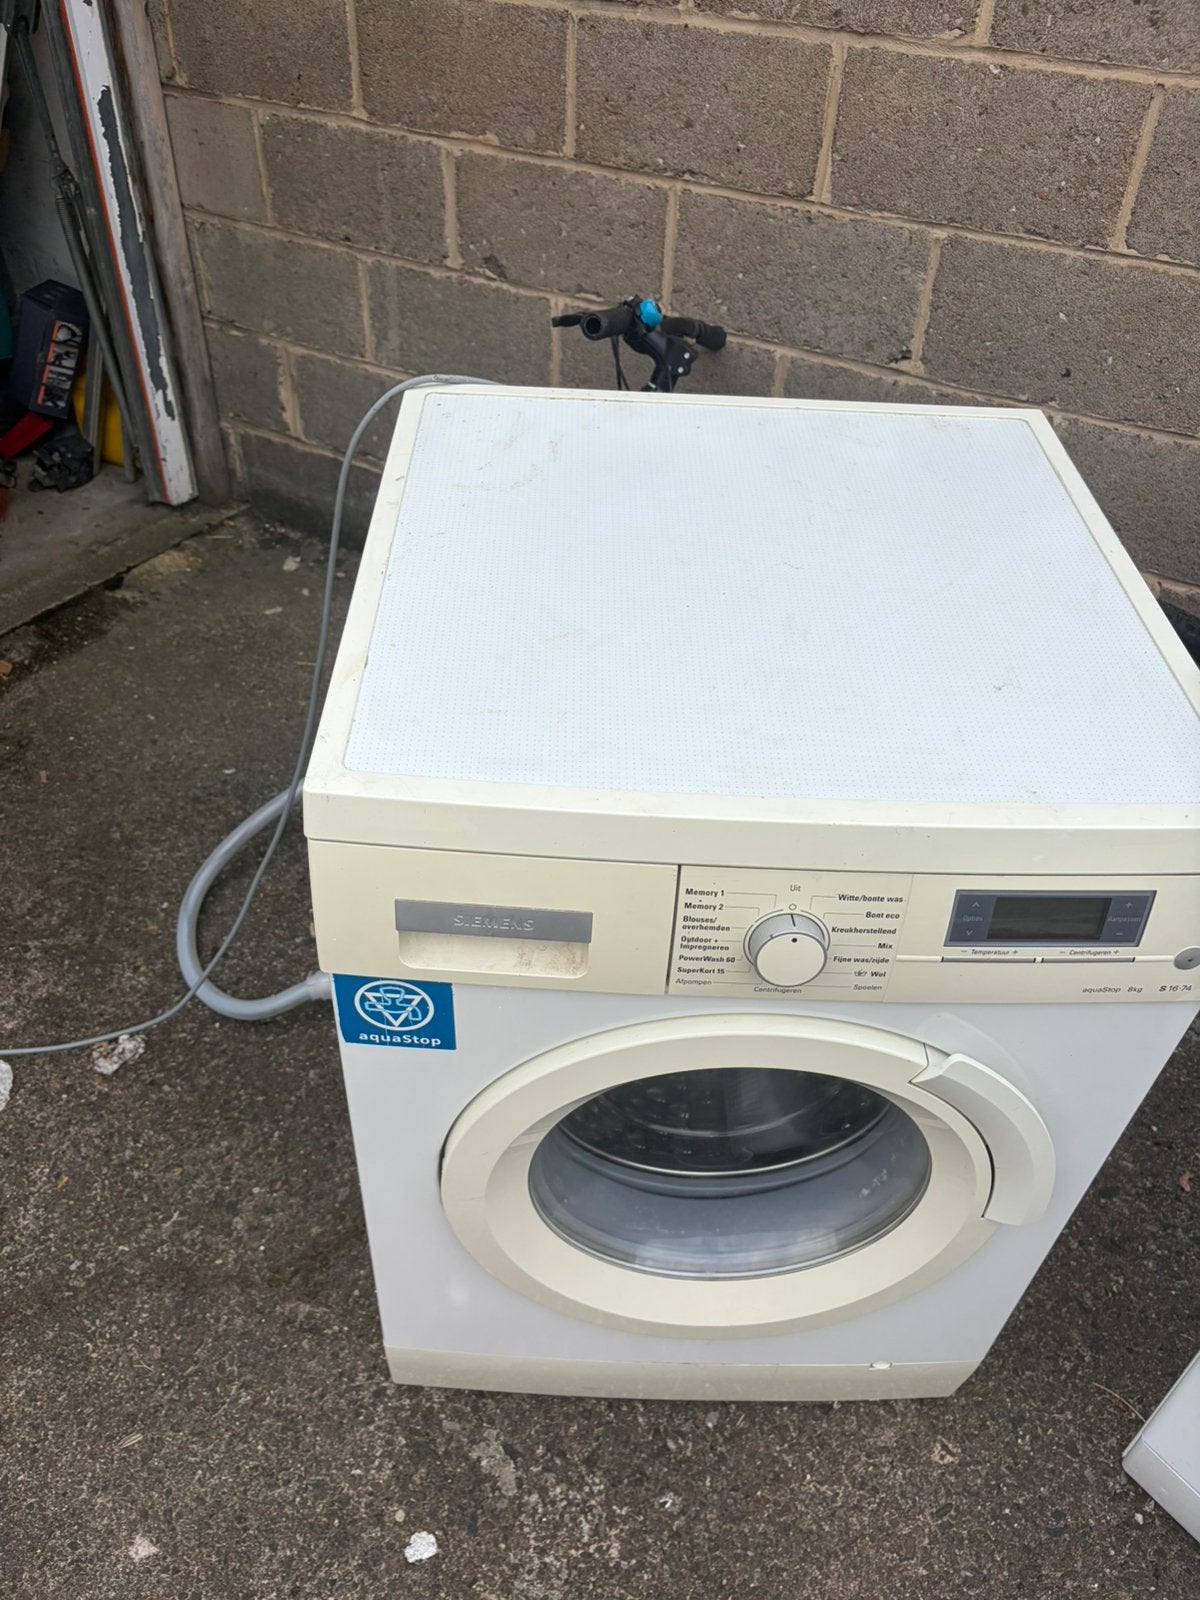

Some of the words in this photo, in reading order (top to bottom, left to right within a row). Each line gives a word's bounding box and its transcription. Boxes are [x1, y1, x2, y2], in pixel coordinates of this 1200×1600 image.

[790, 884, 801, 892] Uit
[685, 888, 719, 897] Memory
[838, 895, 884, 903] Witte/bonte
[684, 902, 717, 911] Memory
[453, 915, 535, 931] SIEMENS
[683, 916, 716, 924] Blouses/
[832, 927, 897, 935] Kreukherstellend
[680, 943, 729, 951] Impregneren
[833, 956, 851, 964] Fijne
[853, 956, 889, 965] was/zijde
[677, 967, 715, 975] SuperKort
[676, 978, 712, 986] Afpompen
[853, 984, 882, 992] Spoelen
[359, 1032, 441, 1047] aquaStop
